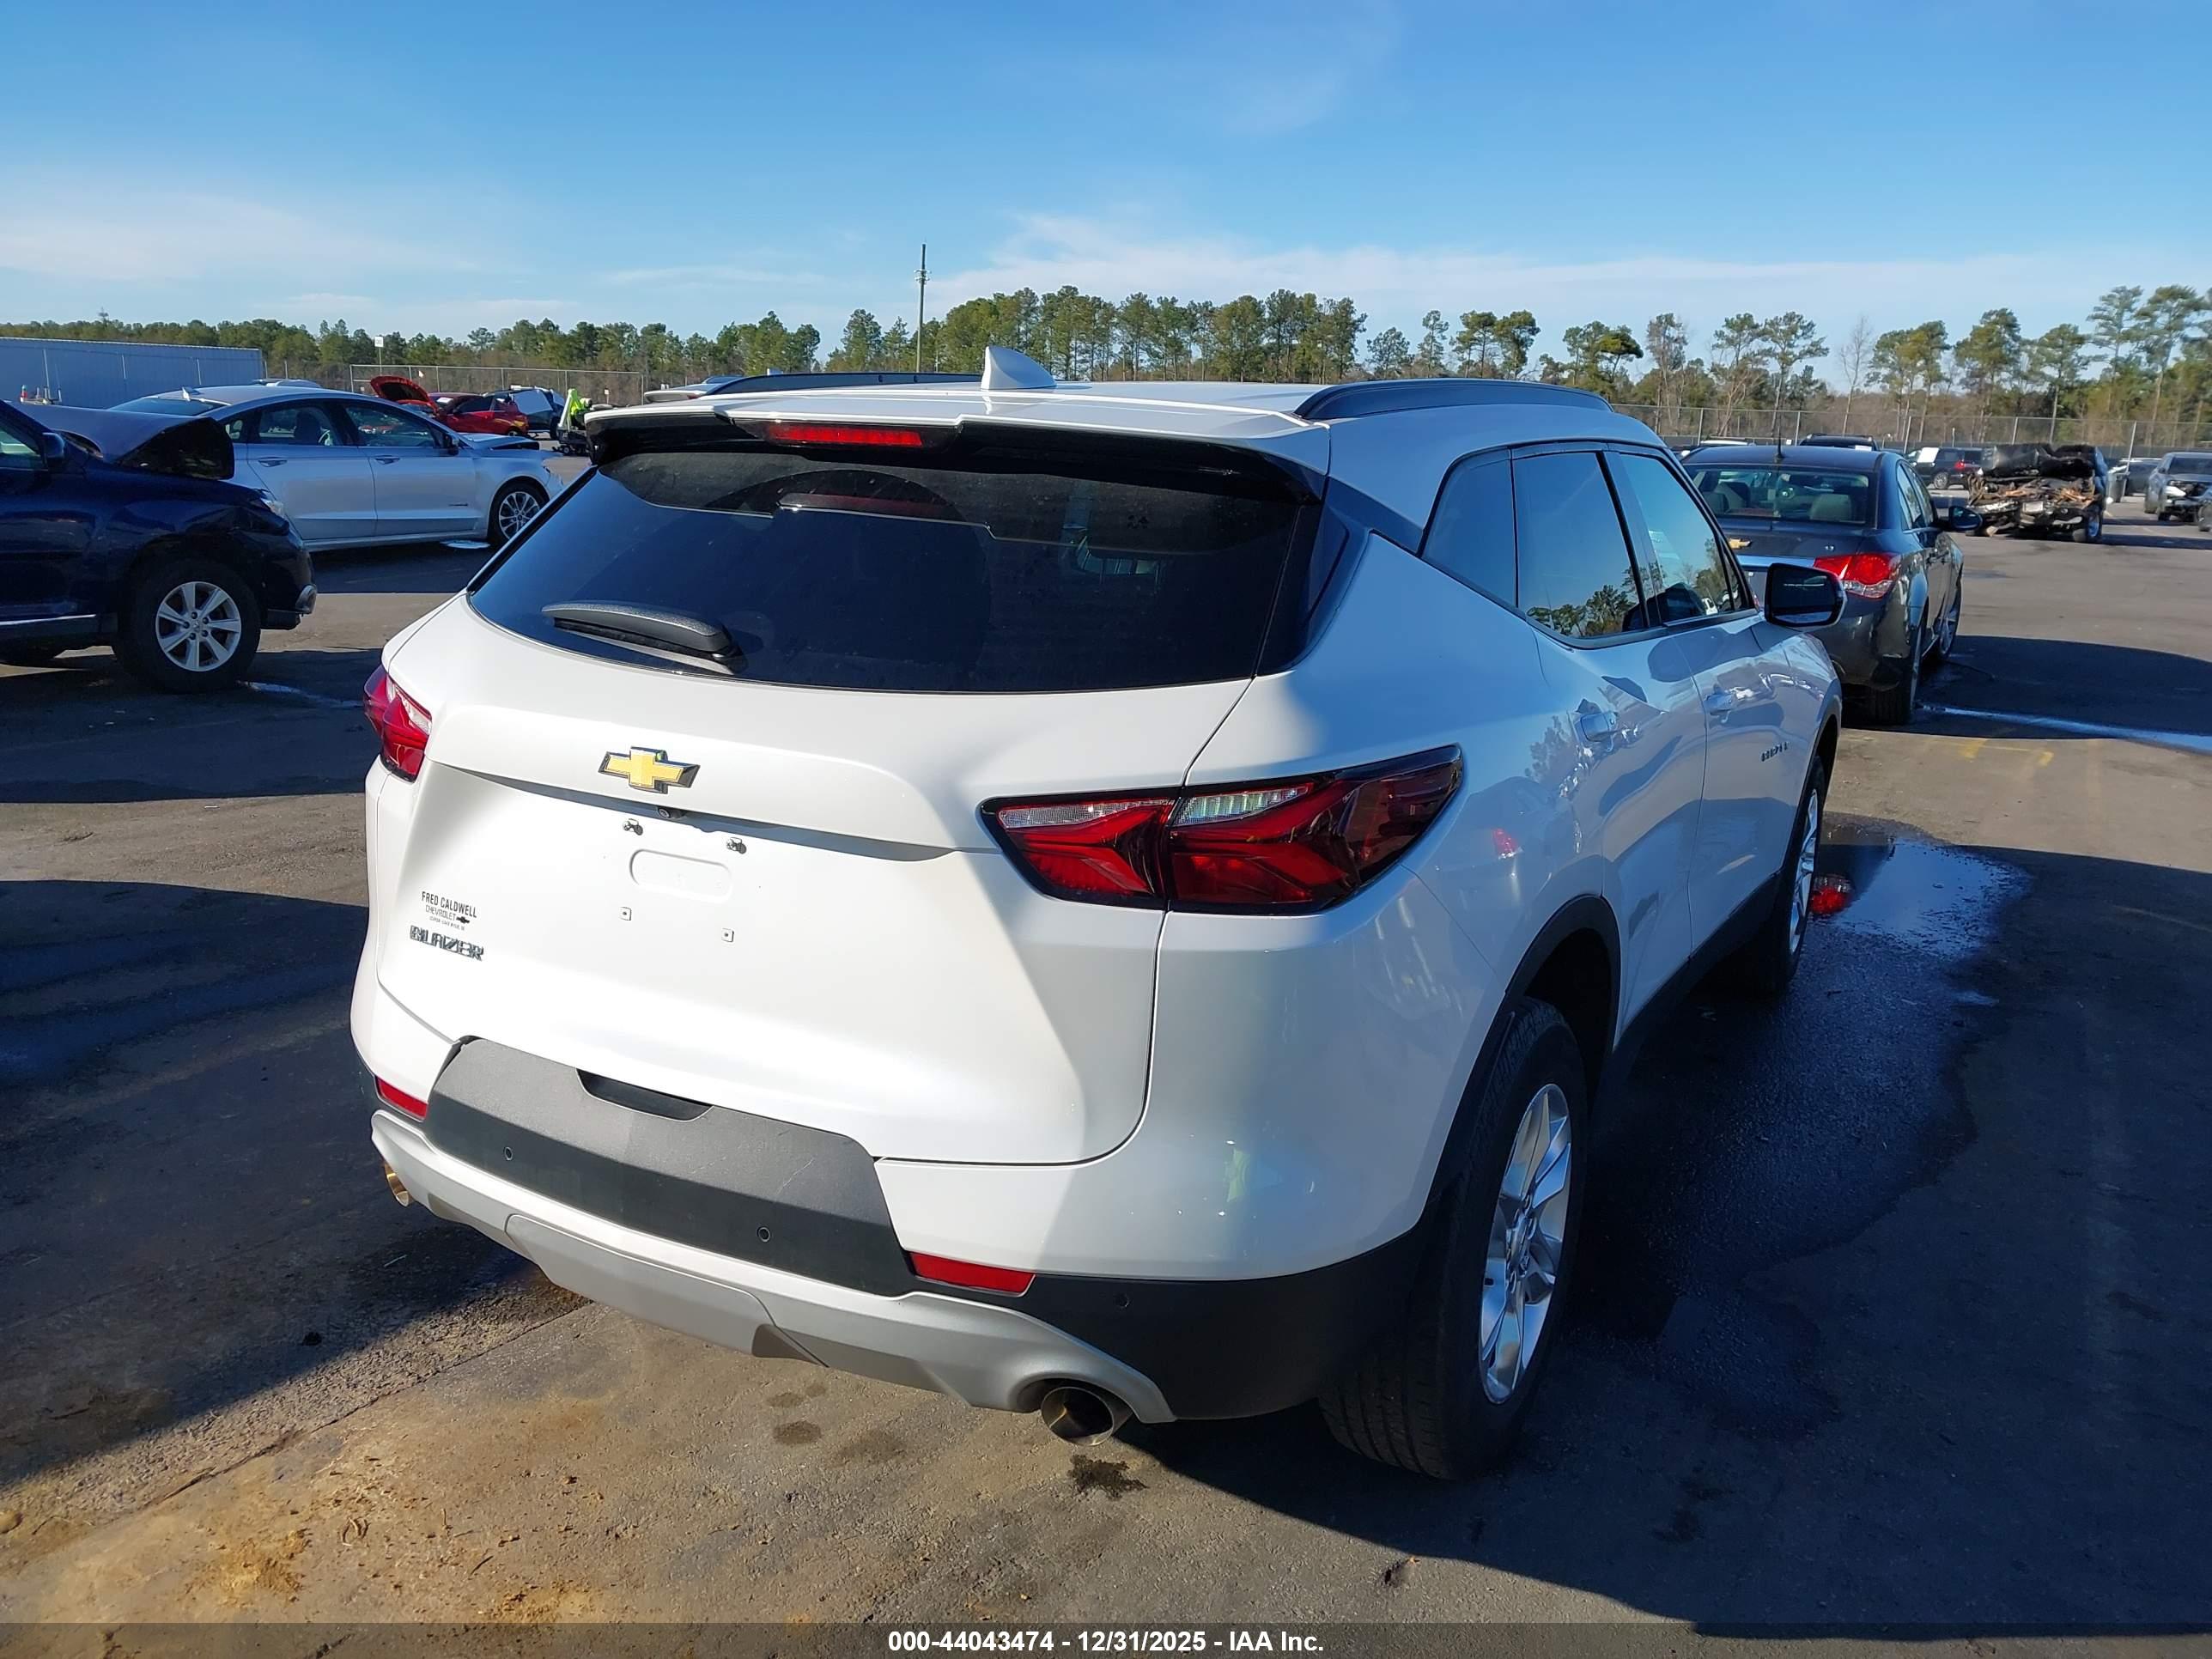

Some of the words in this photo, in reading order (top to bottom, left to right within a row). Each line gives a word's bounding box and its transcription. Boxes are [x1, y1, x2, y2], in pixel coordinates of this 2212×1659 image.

[422, 891, 439, 906] FRED
[441, 896, 477, 918] CALDWELL
[425, 904, 457, 921] CHEVROLET
